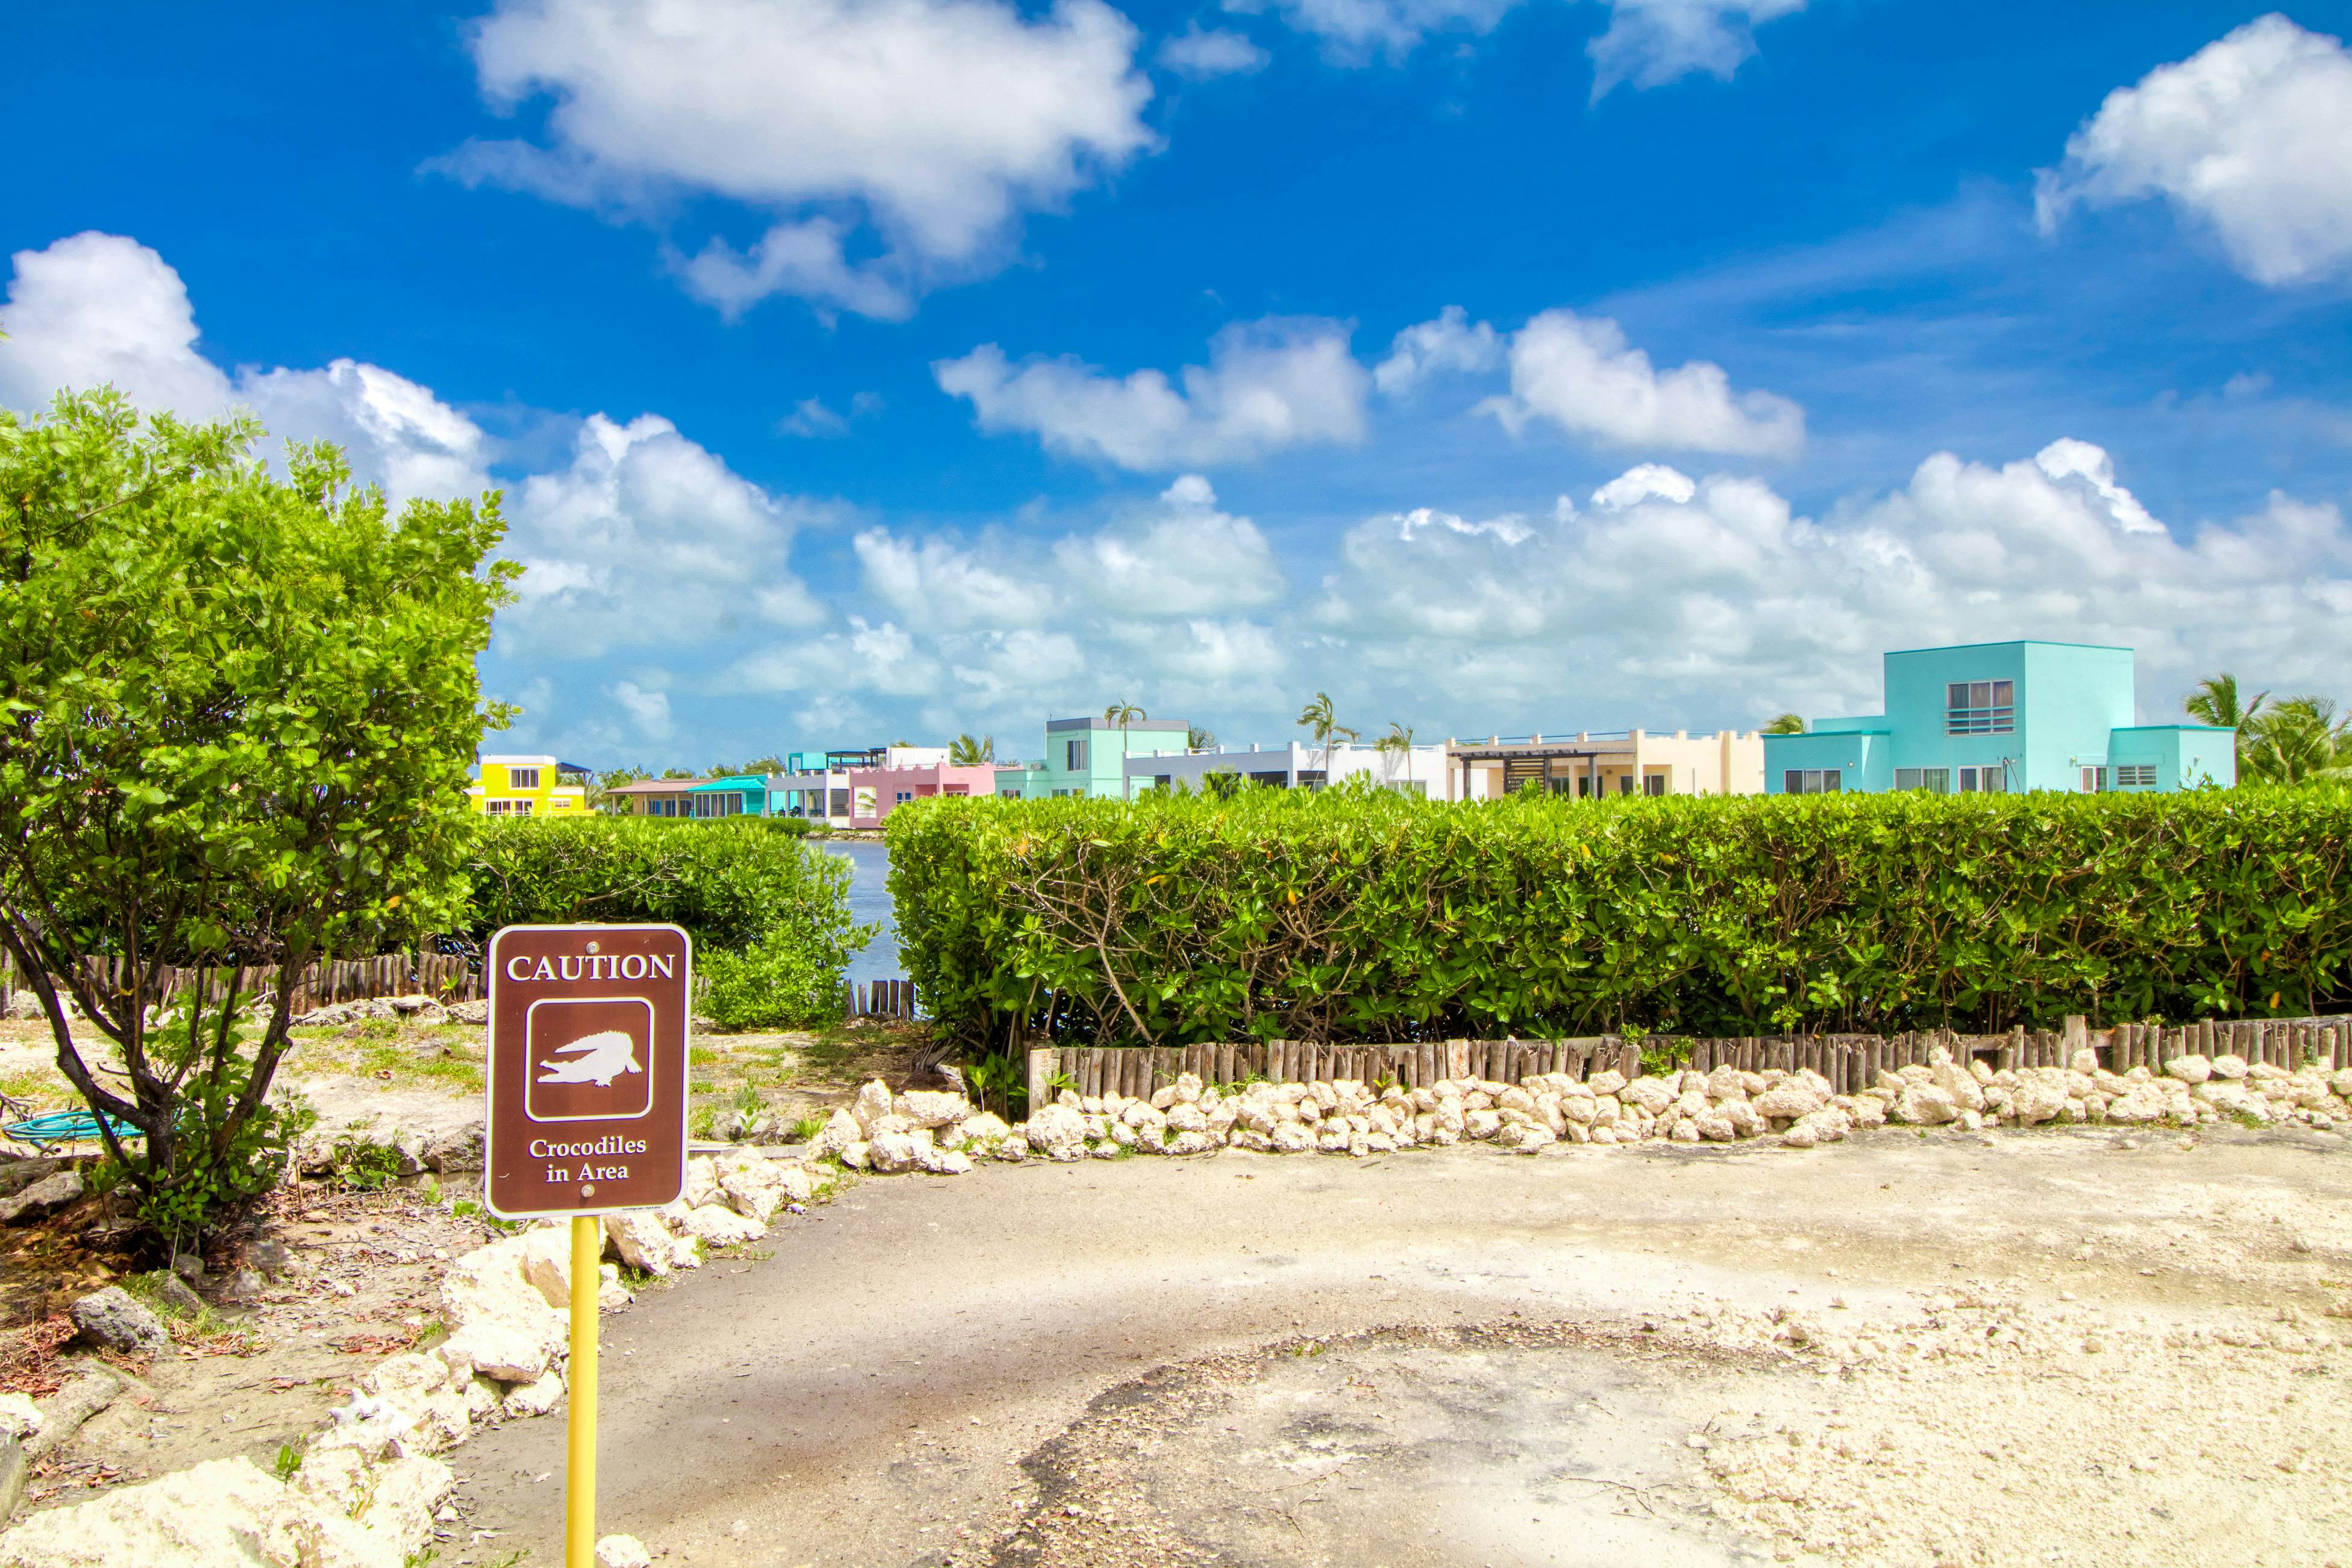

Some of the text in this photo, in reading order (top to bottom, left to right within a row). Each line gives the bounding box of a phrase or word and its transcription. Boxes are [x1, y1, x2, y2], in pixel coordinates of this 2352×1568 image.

[507, 954, 676, 981] CAUTION
[529, 1135, 647, 1158] Crocodiles
[546, 1163, 629, 1182] in Area
